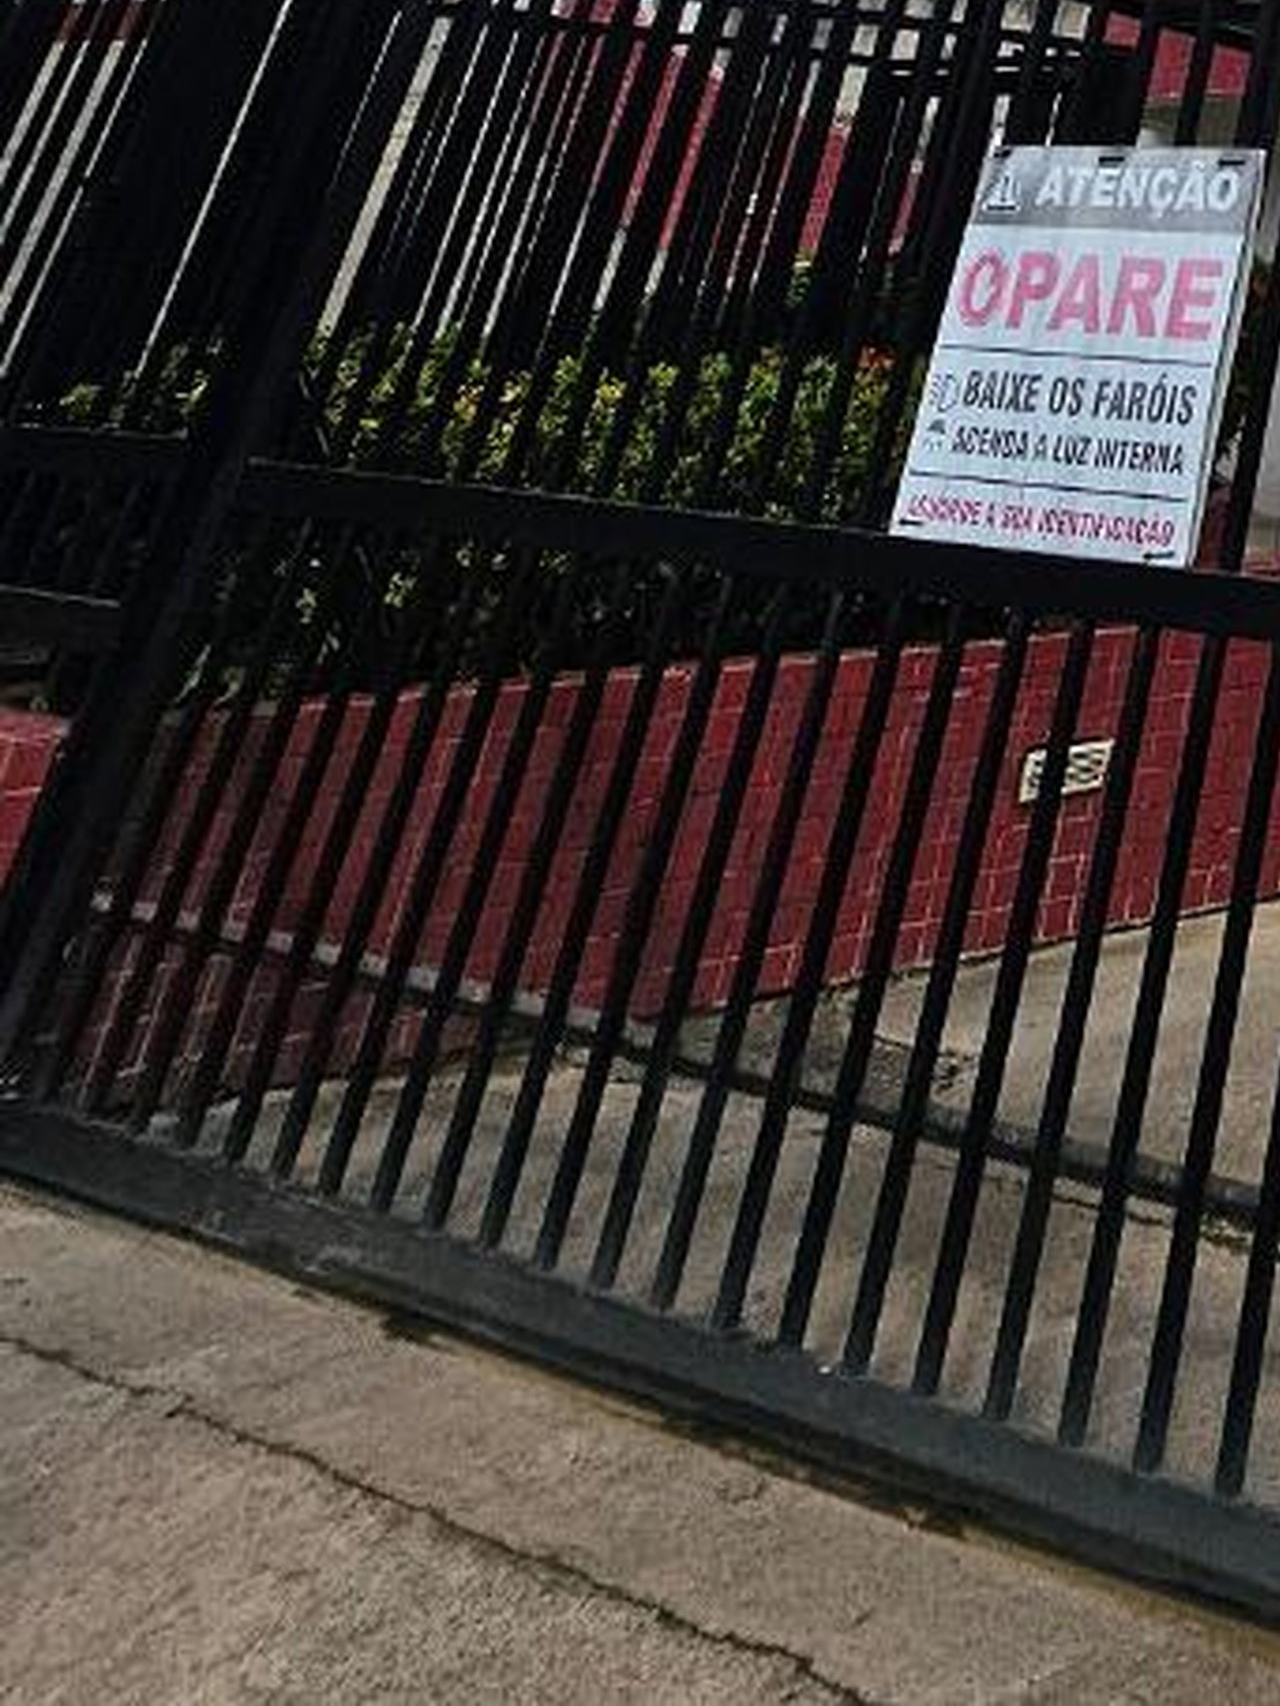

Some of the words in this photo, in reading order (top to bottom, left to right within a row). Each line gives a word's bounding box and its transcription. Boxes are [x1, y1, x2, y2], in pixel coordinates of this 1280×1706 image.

[1035, 160, 1240, 218] ATENÇÃO
[962, 370, 1042, 414] BAIXE
[1049, 377, 1085, 416] OS
[1092, 373, 1198, 426] FARÓIS
[952, 425, 1029, 461] ACENDA
[1032, 433, 1048, 462] A
[1053, 436, 1091, 466] LUZ
[1095, 439, 1184, 475] INTERNA
